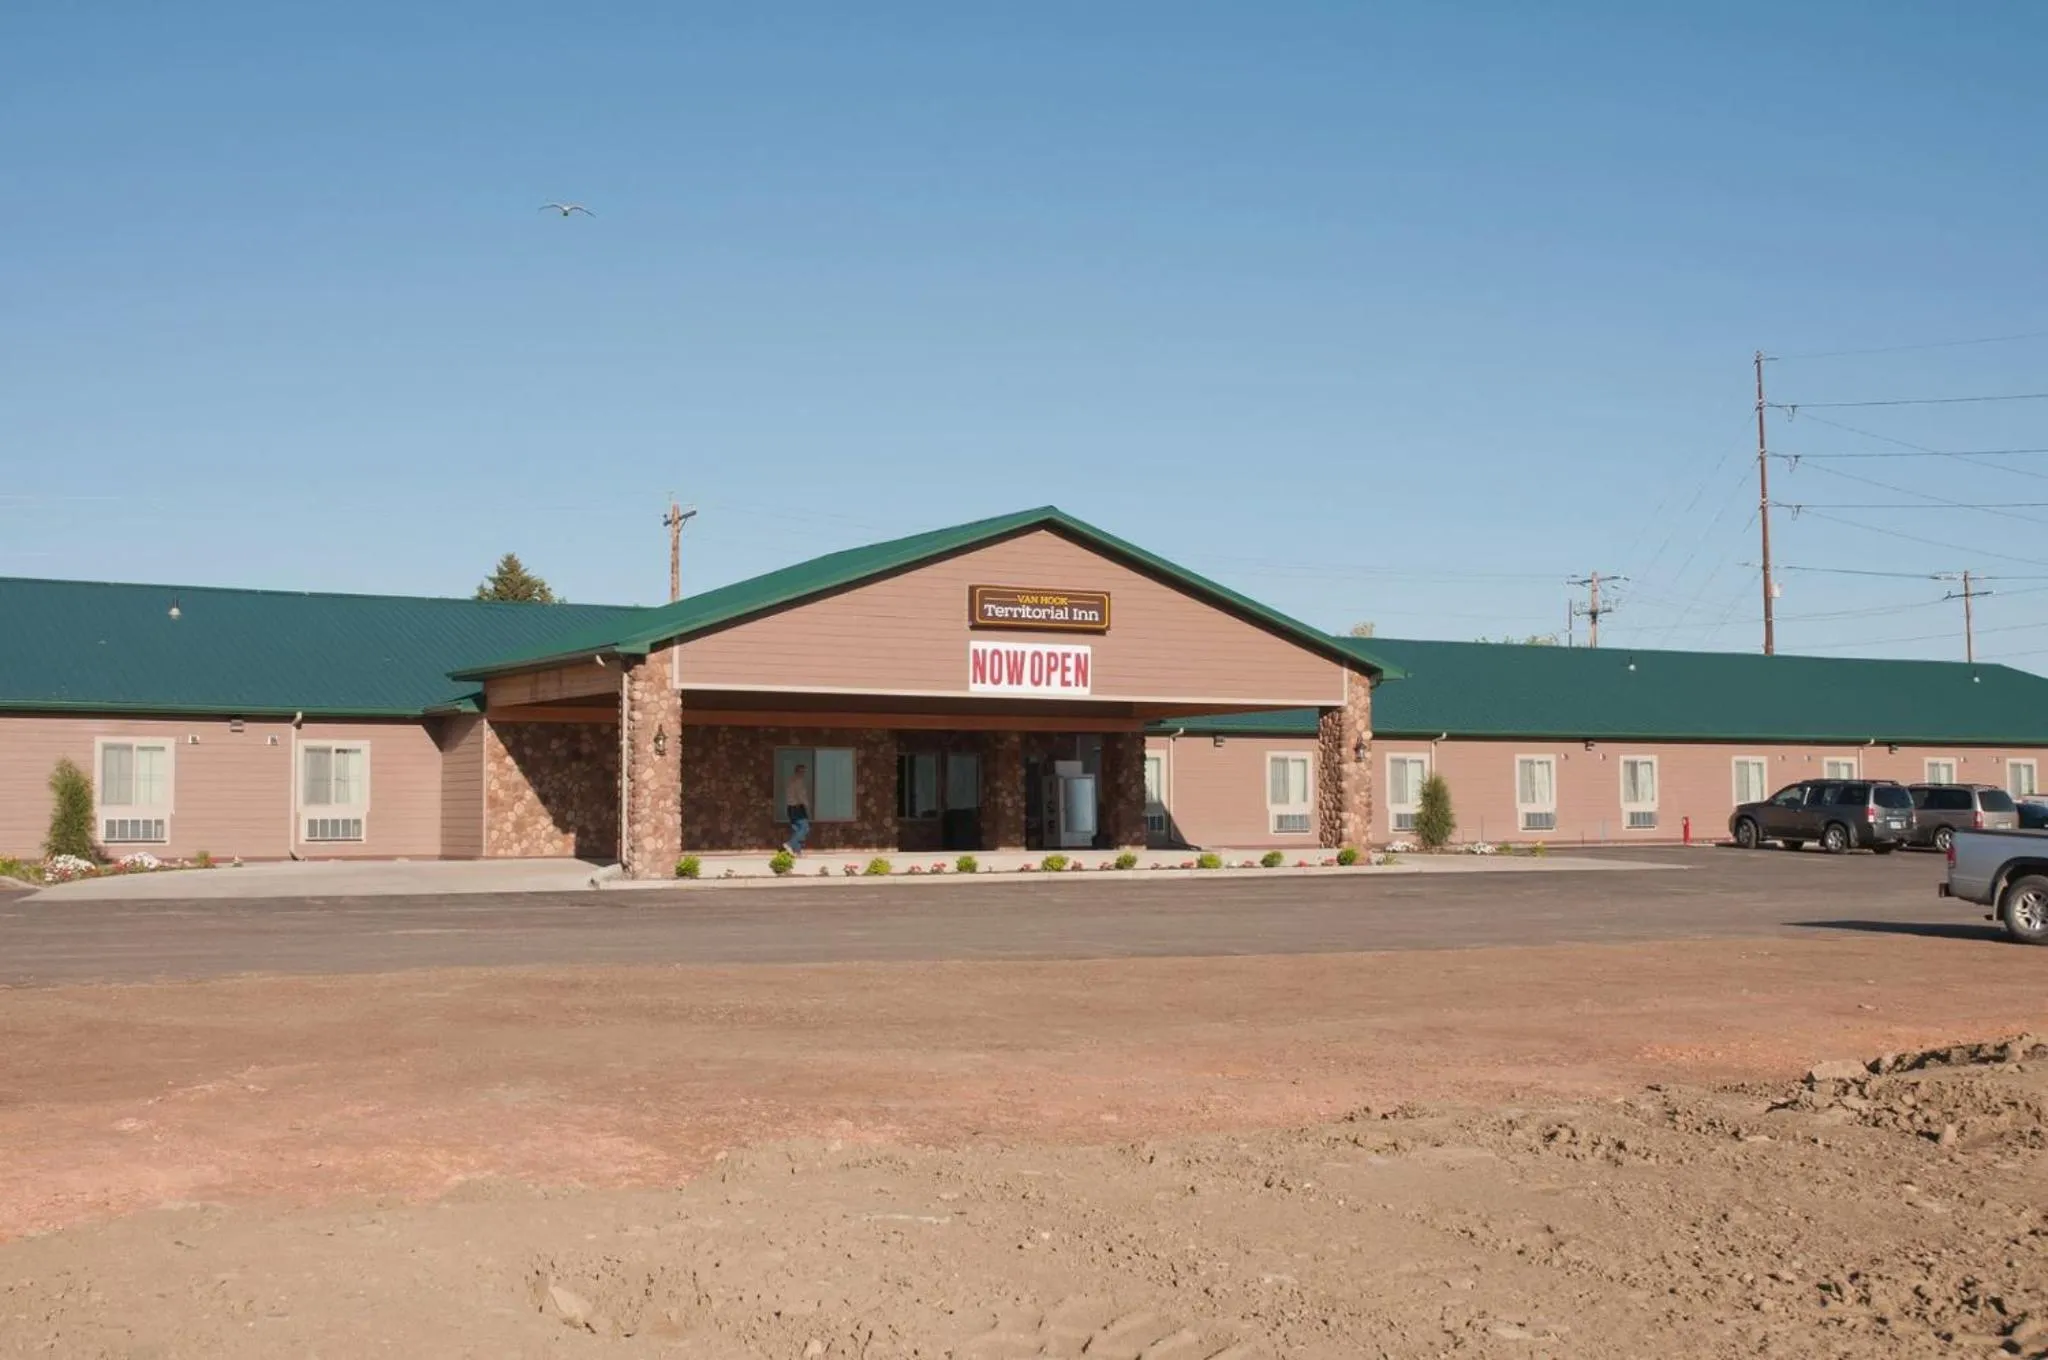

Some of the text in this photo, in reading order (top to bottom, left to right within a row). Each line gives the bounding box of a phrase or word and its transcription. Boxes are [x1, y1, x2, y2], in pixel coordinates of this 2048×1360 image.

[1017, 595, 1068, 605] VAN HOOK
[984, 604, 1099, 621] Territorial Inn
[972, 649, 1089, 688] NOW OPEN
